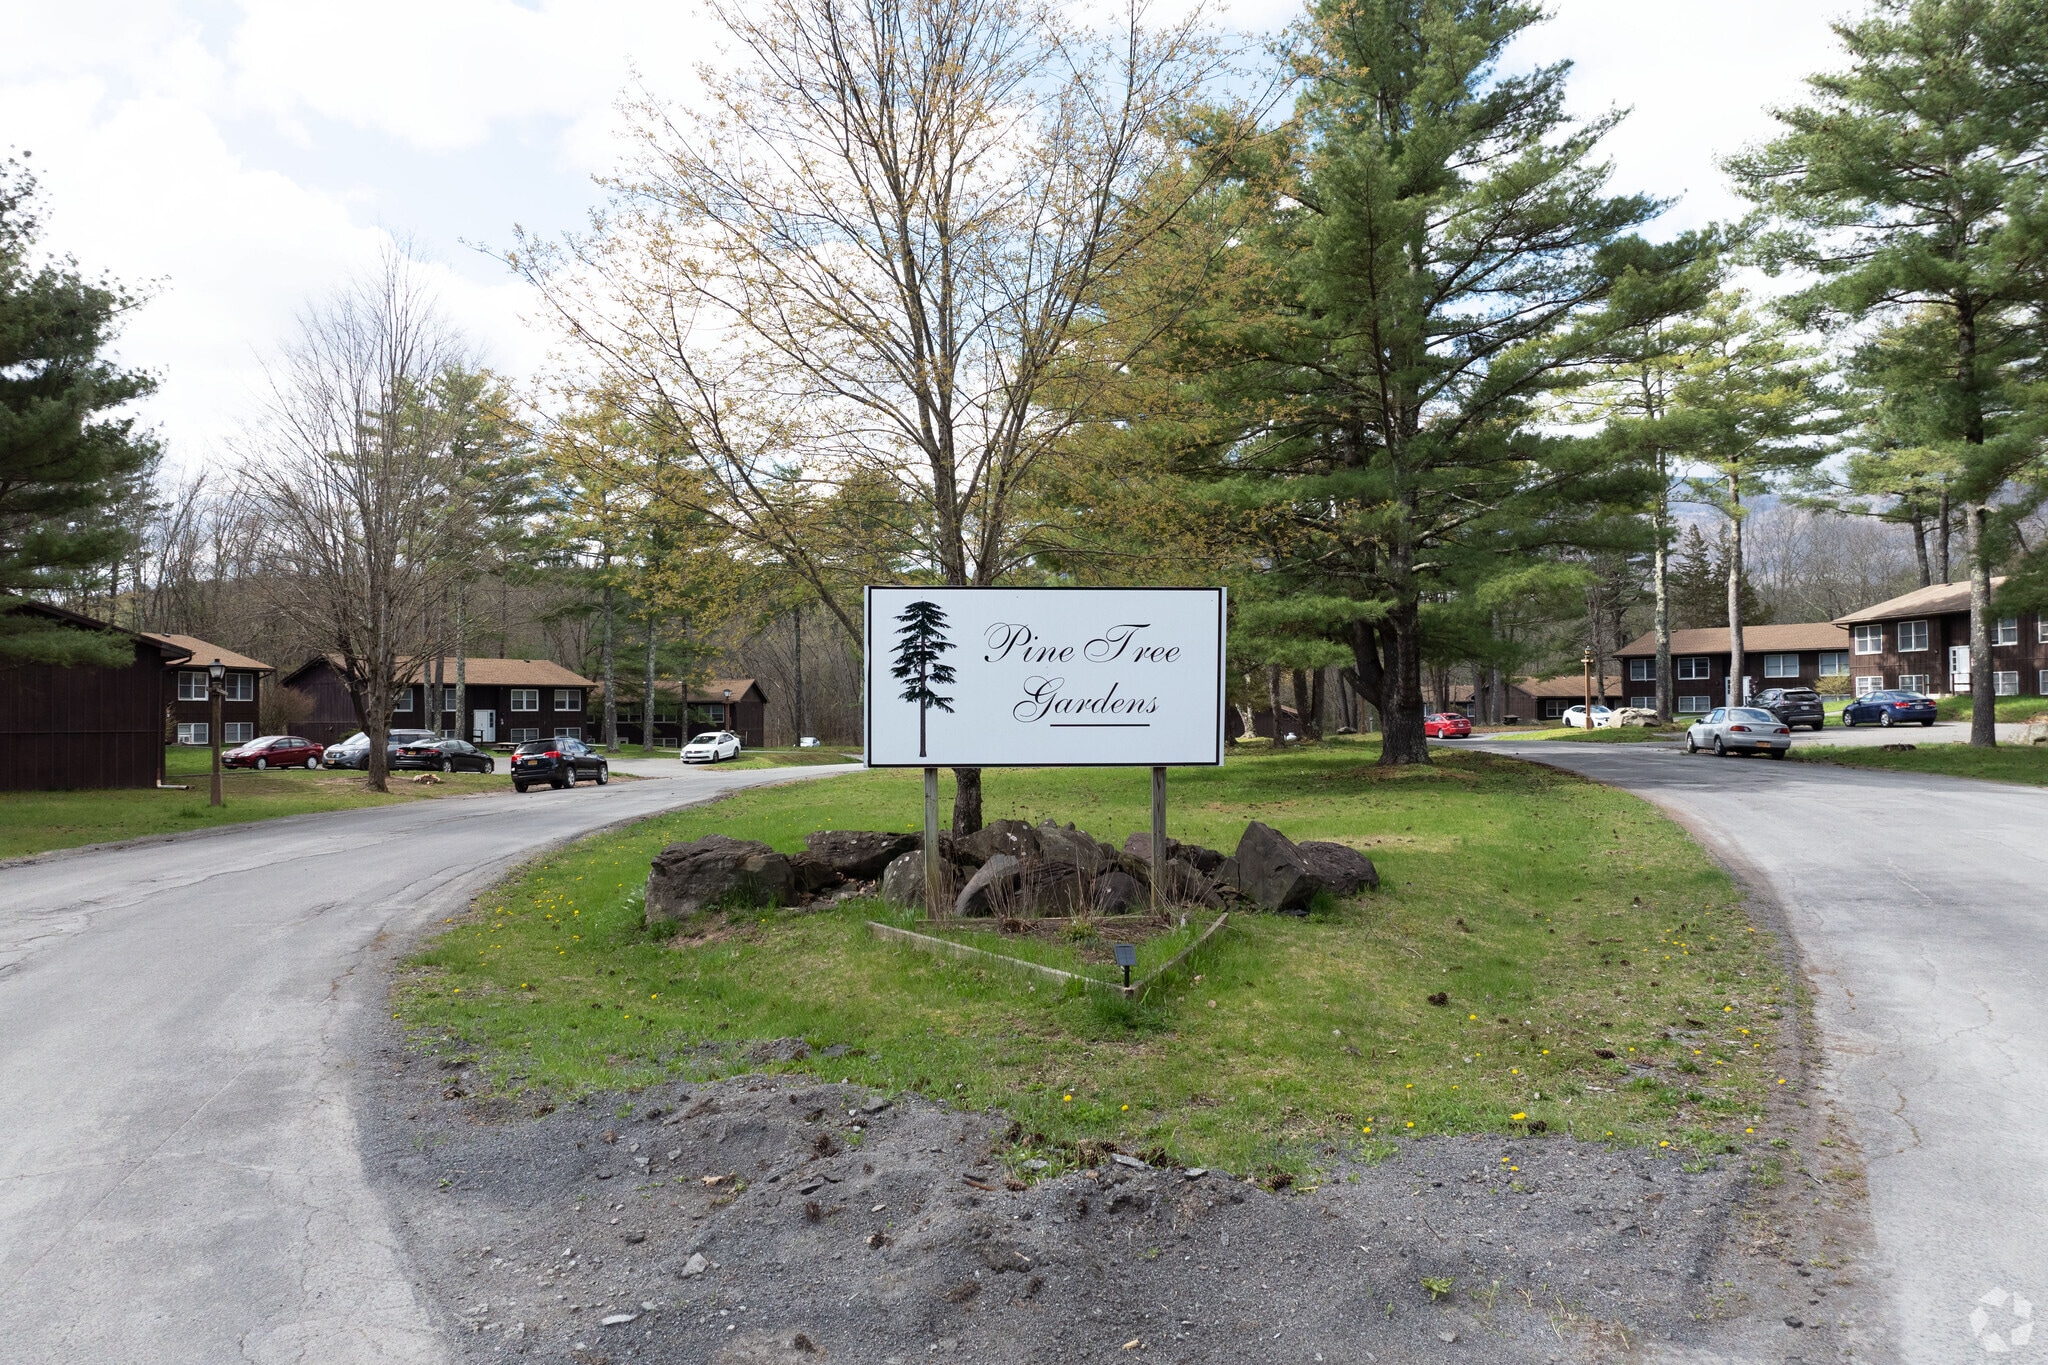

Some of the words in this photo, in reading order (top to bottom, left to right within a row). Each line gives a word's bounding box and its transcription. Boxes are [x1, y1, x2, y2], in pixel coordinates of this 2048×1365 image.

[984, 622, 1075, 663] Pine
[1083, 623, 1181, 663] Tree
[1012, 675, 1159, 723] Gardens
